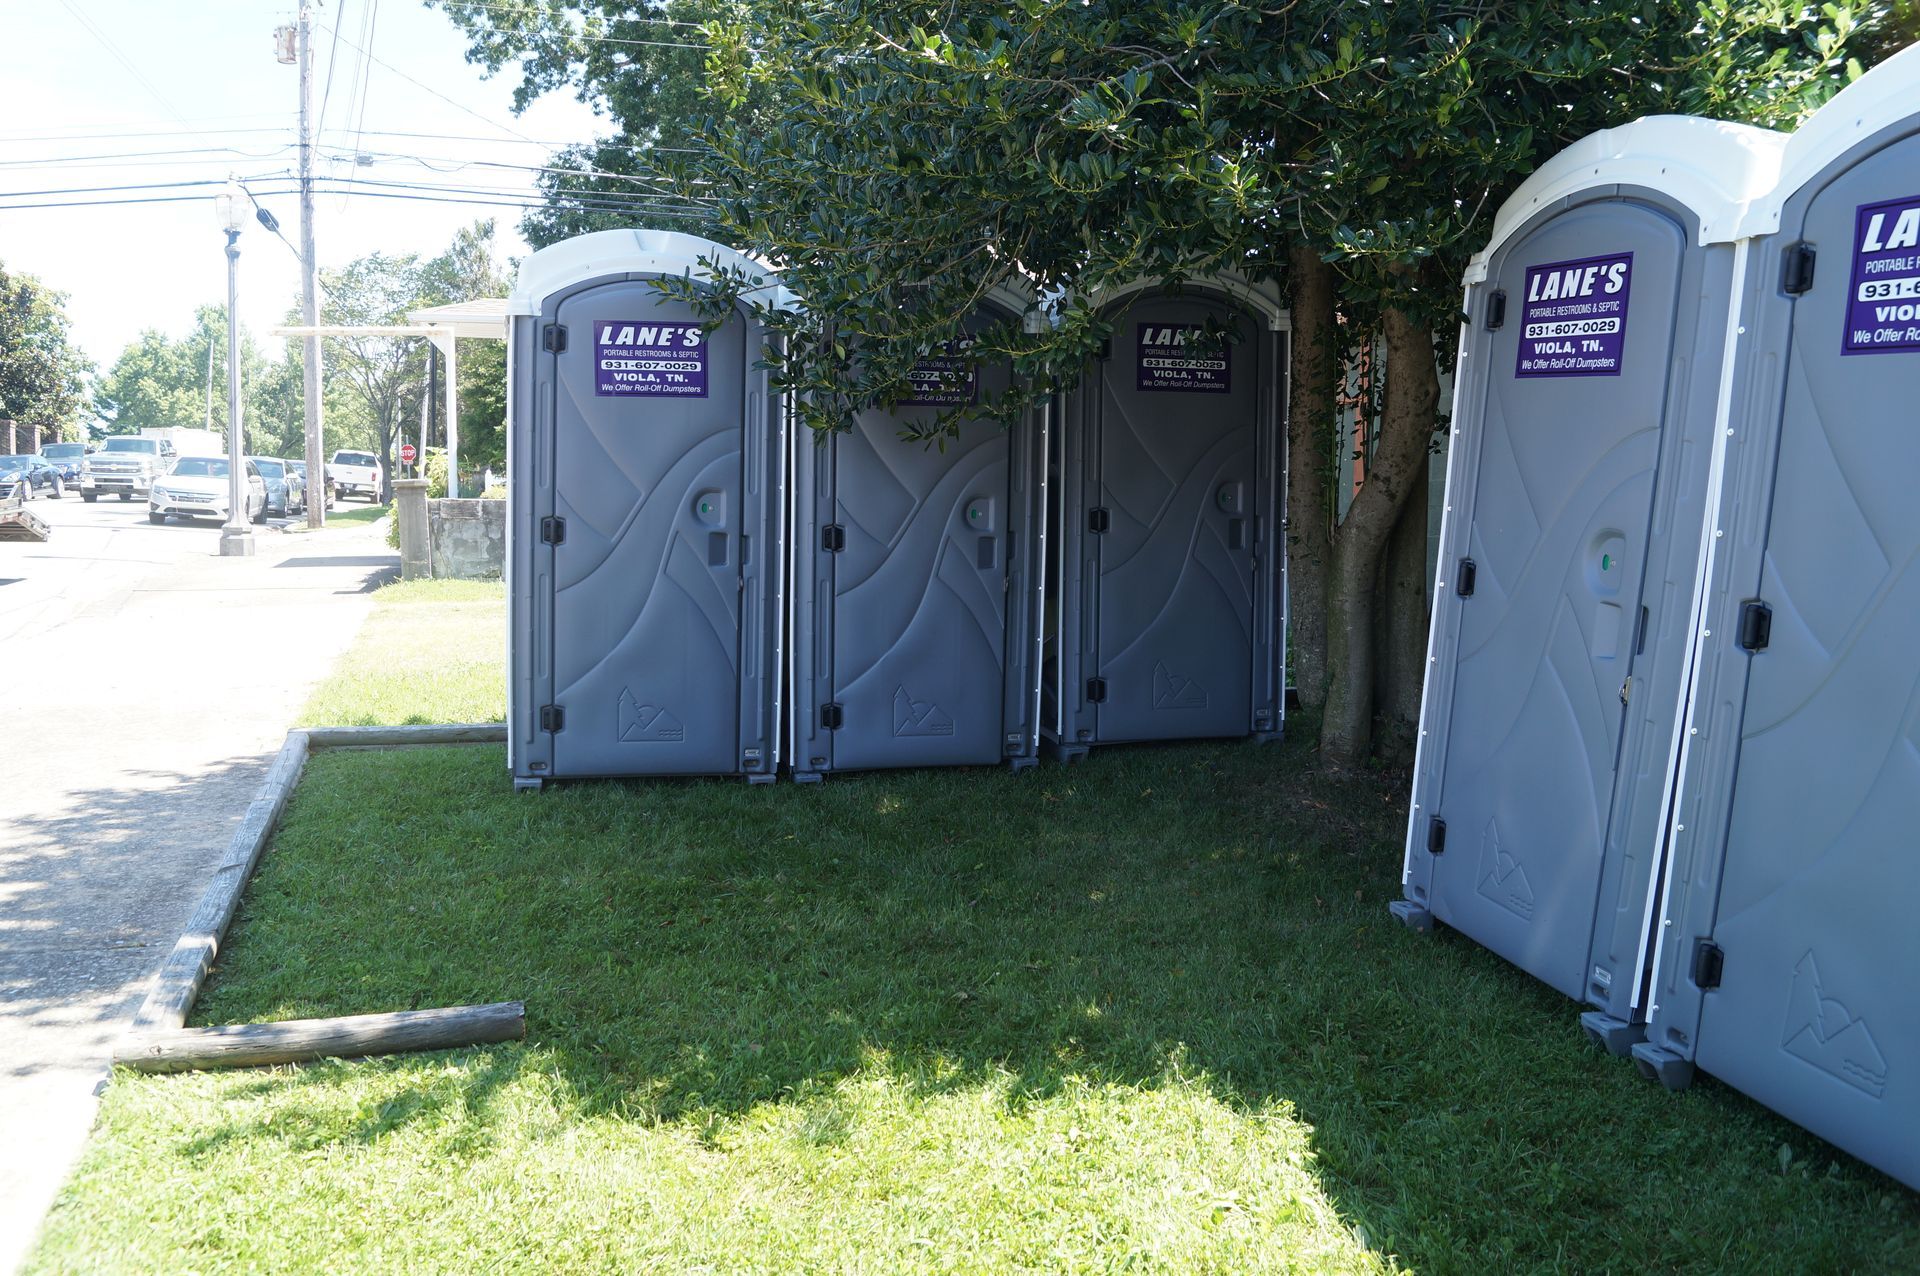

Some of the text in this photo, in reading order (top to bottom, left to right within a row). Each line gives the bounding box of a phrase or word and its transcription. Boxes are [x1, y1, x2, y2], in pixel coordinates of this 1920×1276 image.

[1865, 256, 1914, 274] PORTABLE
[1528, 262, 1627, 302] LANE'S
[1530, 301, 1620, 318] PORTABLE RESTROOMS & SEPTIC
[1528, 320, 1616, 336] 931-607-0029
[600, 326, 702, 347] LANE'S
[1854, 330, 1871, 344] We
[1874, 328, 1904, 342] Offer
[604, 349, 634, 357] PORTABLE
[634, 350, 672, 358] RESTROOMS
[1534, 340, 1604, 354] VIOLA, TN.
[605, 361, 698, 370] 931-607-0029
[1146, 360, 1222, 368] 931-607-0029
[1522, 357, 1615, 370] We Offer Roll-Off Dumpsters
[614, 373, 688, 383] VIOLA, TN.
[1153, 370, 1214, 380] VIOLA, TN.
[634, 384, 662, 392] Roll-Off
[663, 384, 701, 394] Dumpsters
[1193, 381, 1224, 389] Dumpsters
